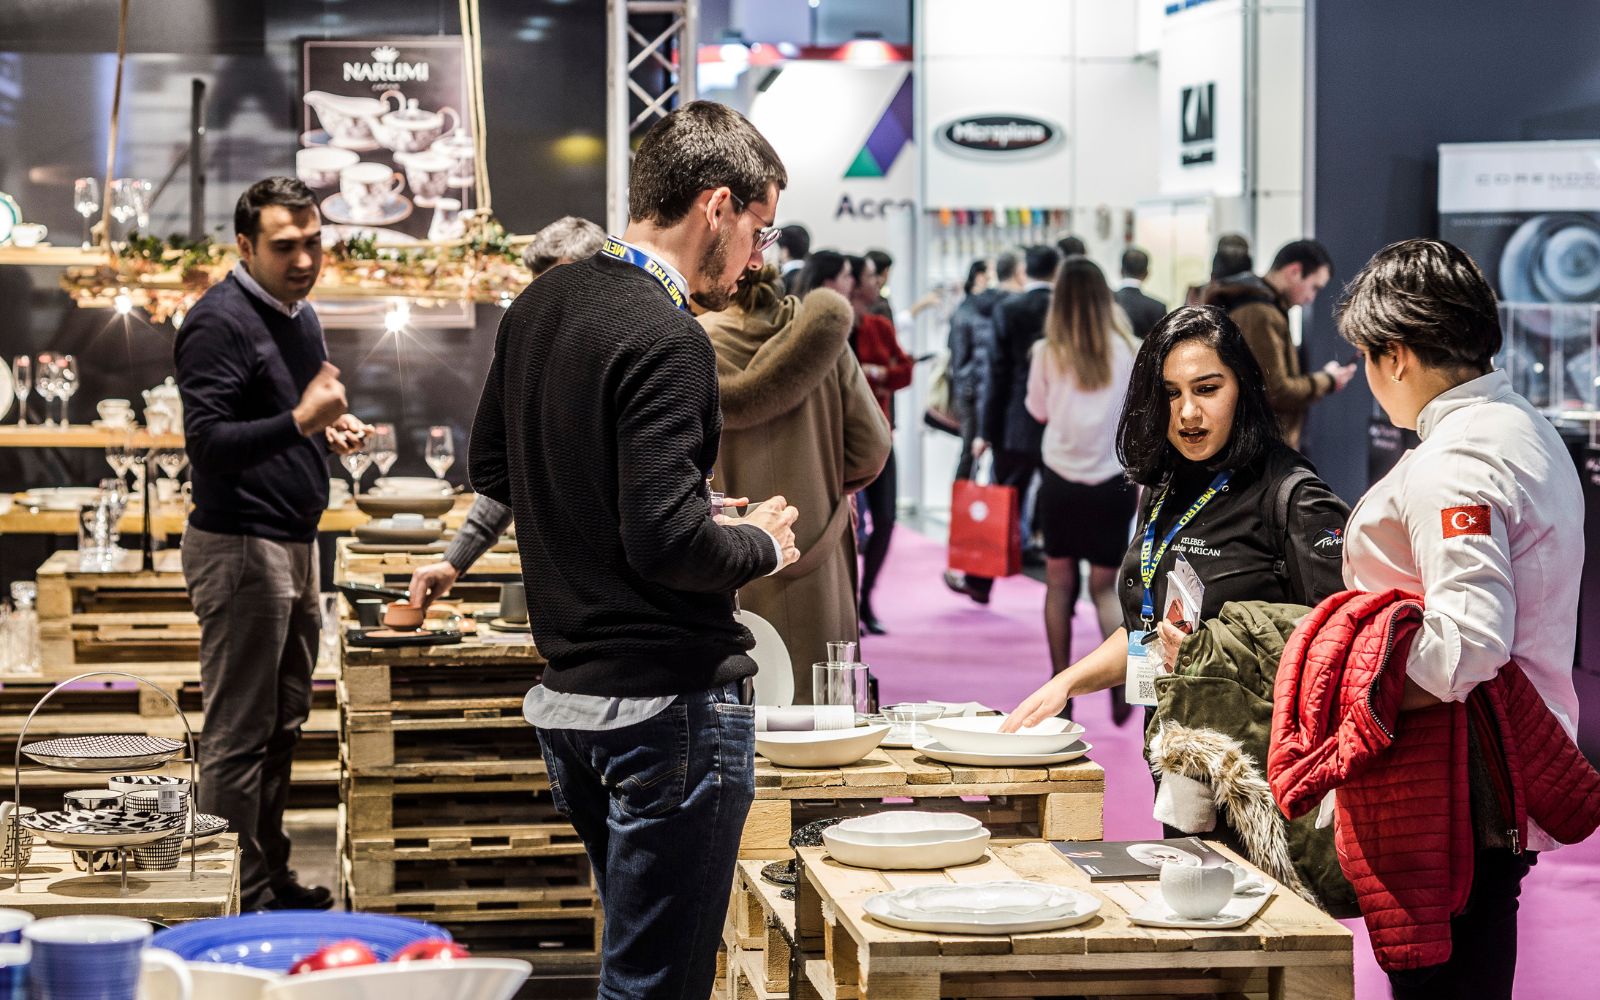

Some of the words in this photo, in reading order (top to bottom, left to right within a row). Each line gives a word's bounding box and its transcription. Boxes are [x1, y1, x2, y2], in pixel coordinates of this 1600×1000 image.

[342, 62, 430, 82] NARUMI
[644, 258, 683, 307] METRO
[1179, 487, 1217, 526] METRO
[1180, 536, 1206, 547] KELEBEK
[1188, 545, 1221, 557] ARICAN
[1141, 541, 1152, 583] METRO
